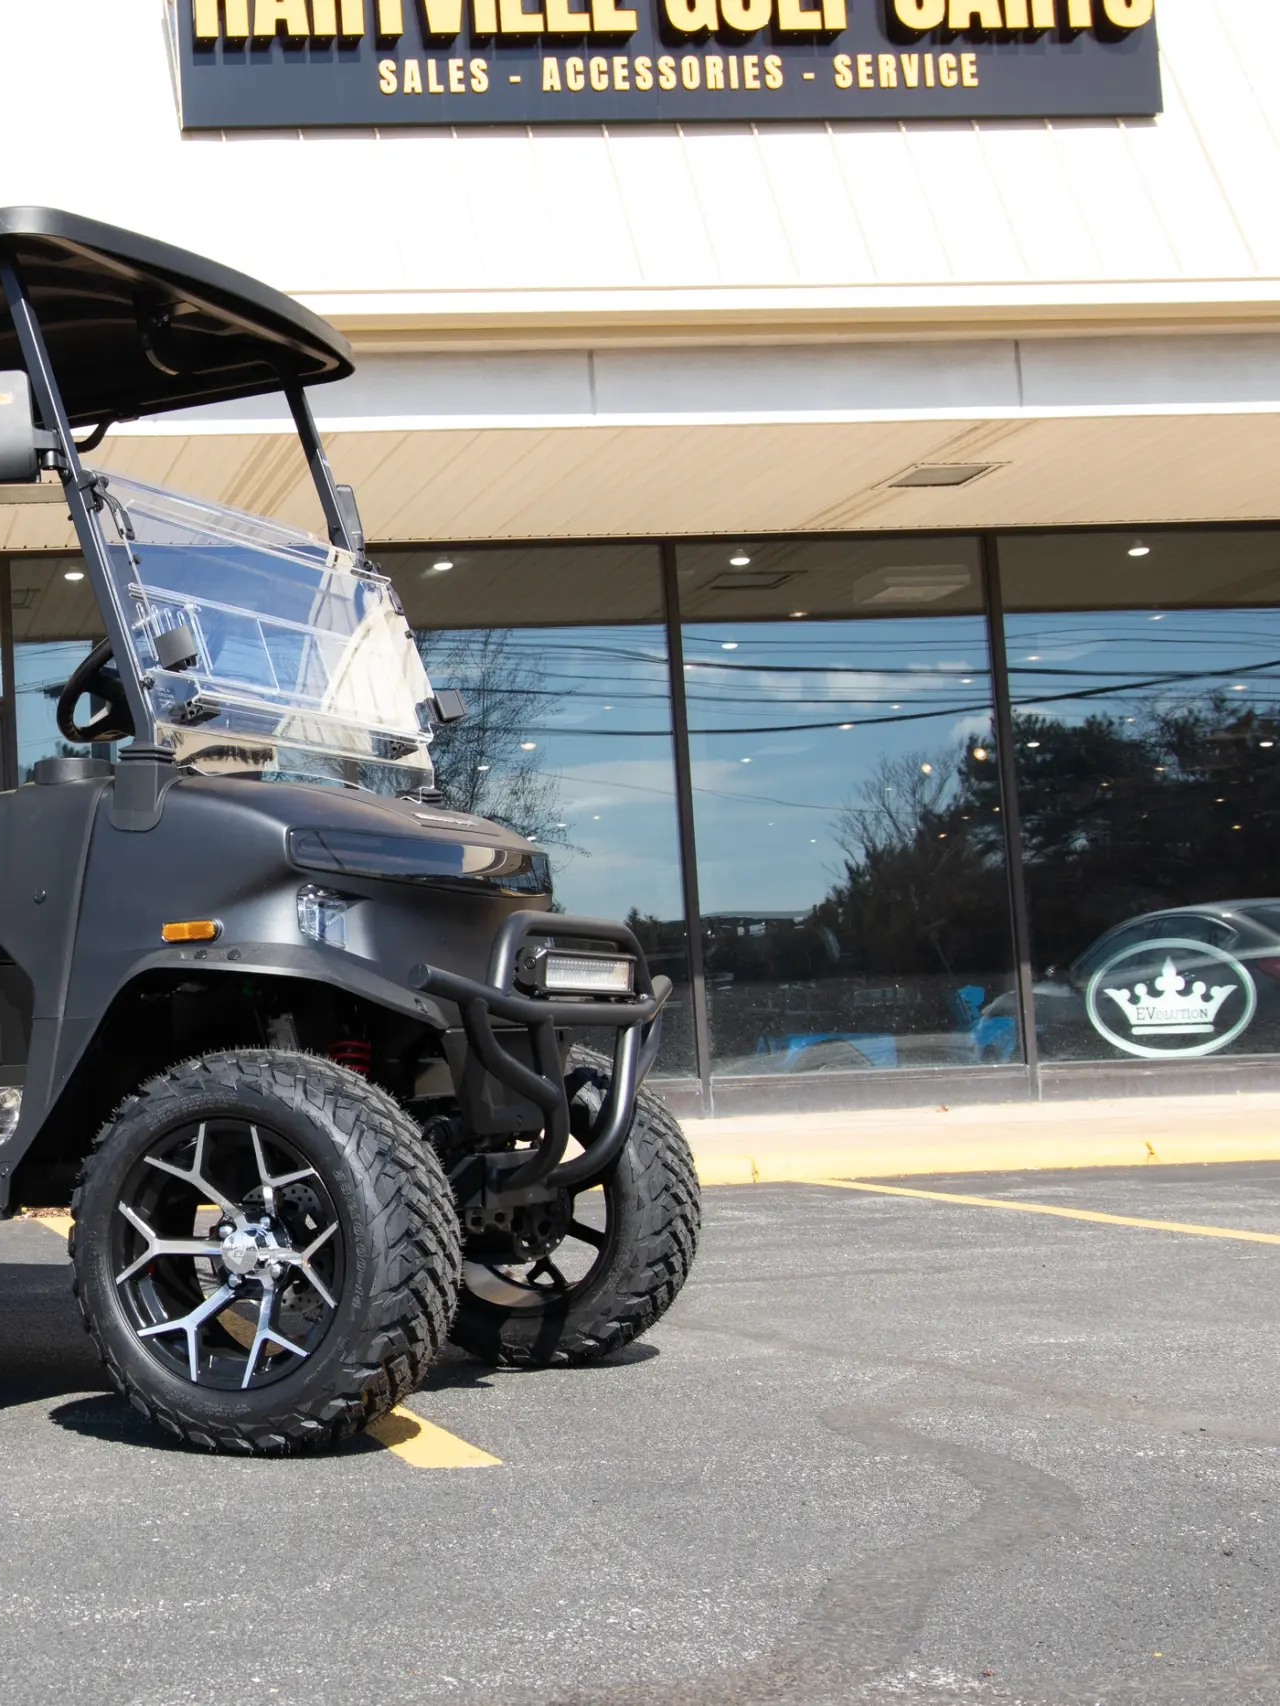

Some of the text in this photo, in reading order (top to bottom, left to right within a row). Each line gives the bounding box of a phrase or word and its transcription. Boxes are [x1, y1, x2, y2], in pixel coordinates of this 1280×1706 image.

[378, 58, 489, 94] SALES
[542, 54, 784, 91] ACCESSORIES
[833, 52, 979, 89] SERVICE
